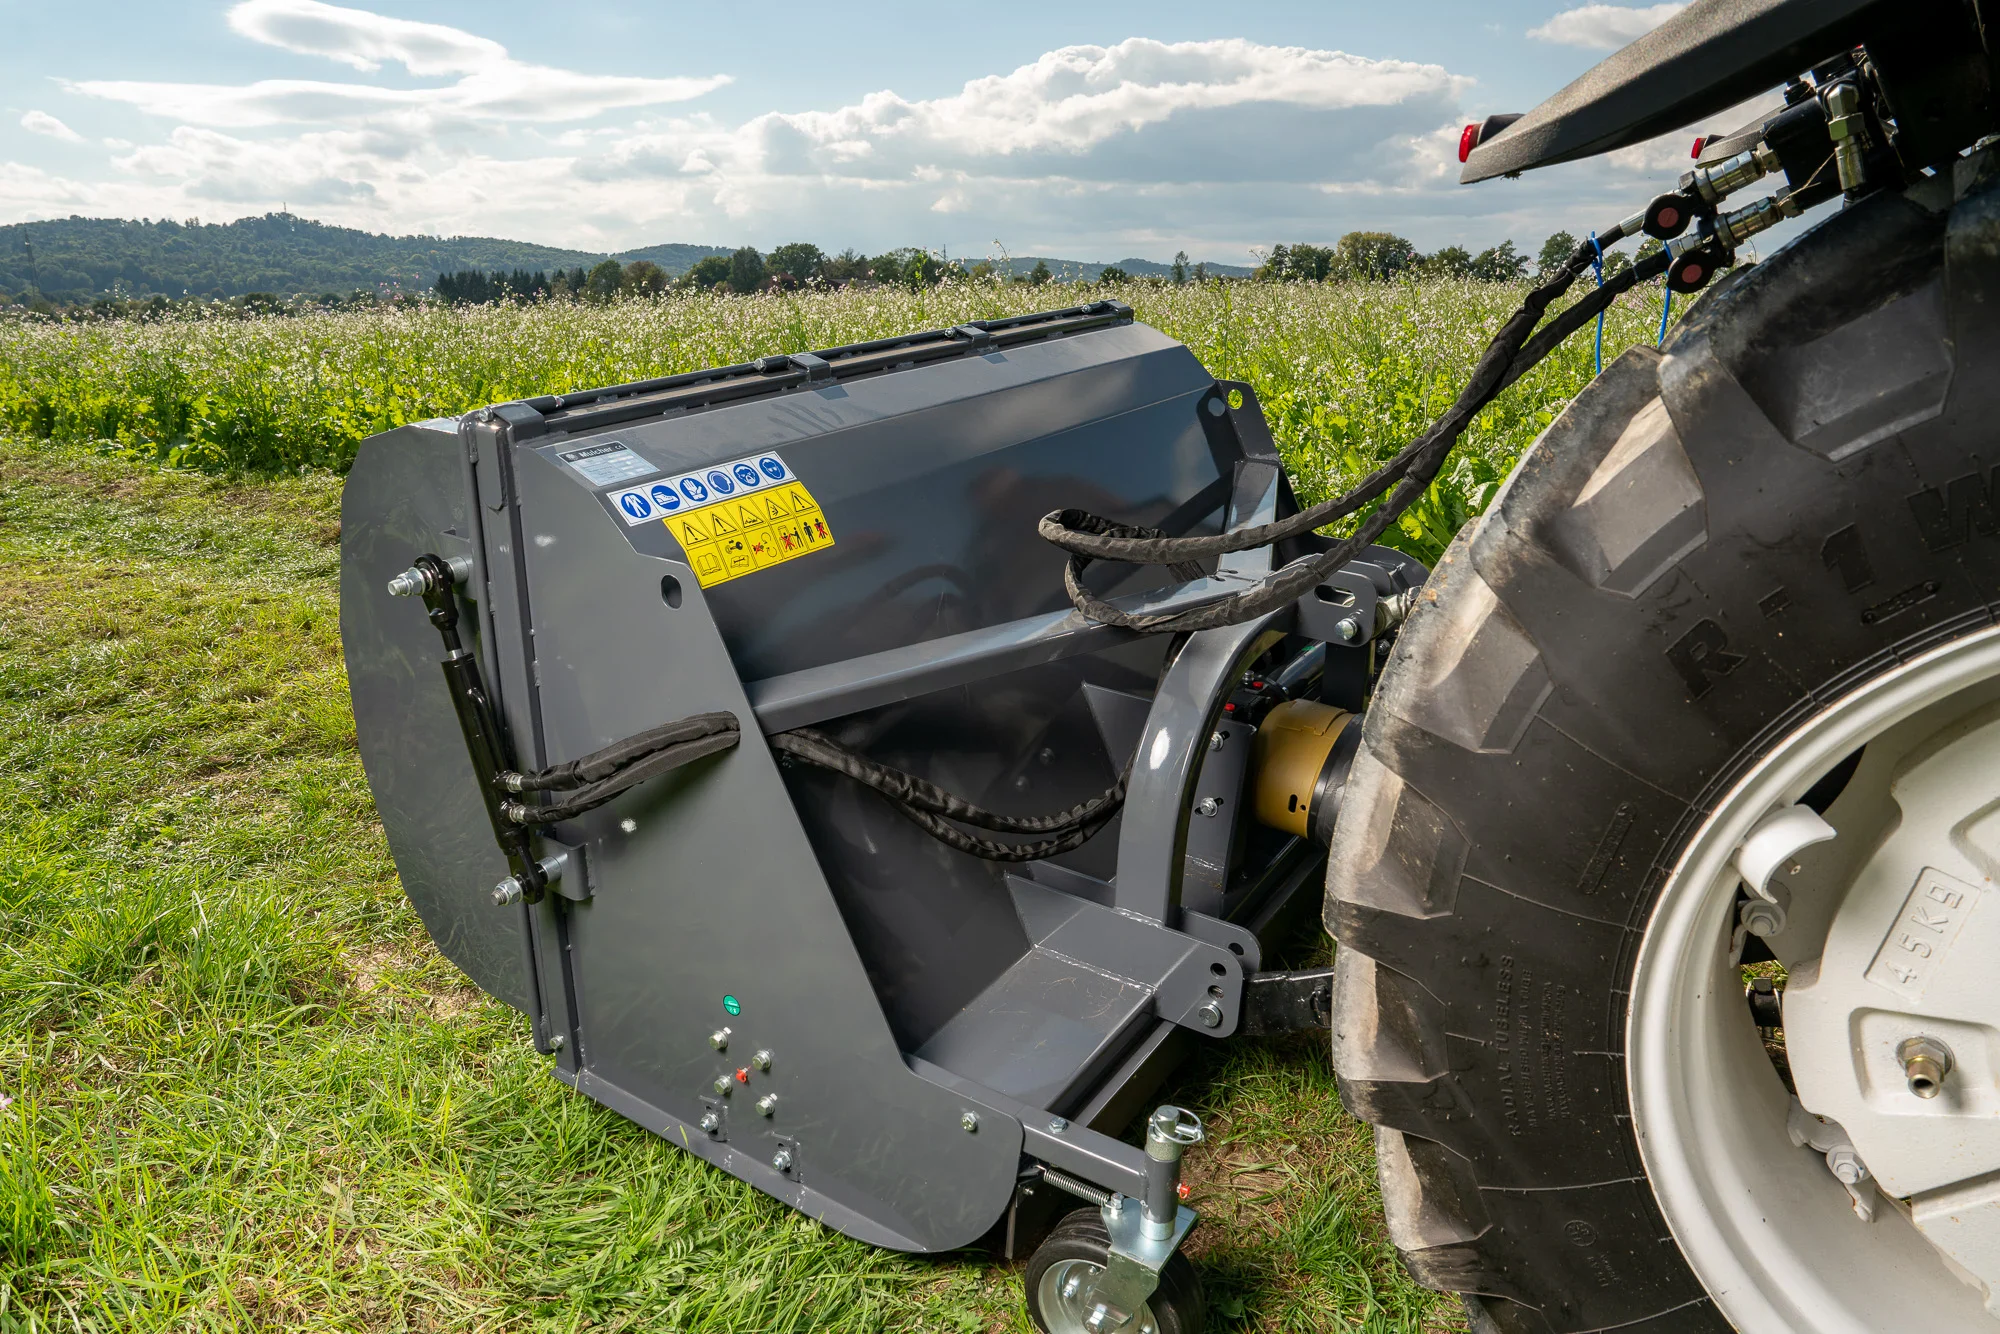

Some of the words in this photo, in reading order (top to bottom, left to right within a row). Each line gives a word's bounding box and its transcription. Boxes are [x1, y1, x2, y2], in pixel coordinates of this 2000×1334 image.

[579, 446, 613, 458] Mulcher
[1496, 954, 1515, 1055] TUBELESS
[1497, 1060, 1521, 1136] RADIAL
